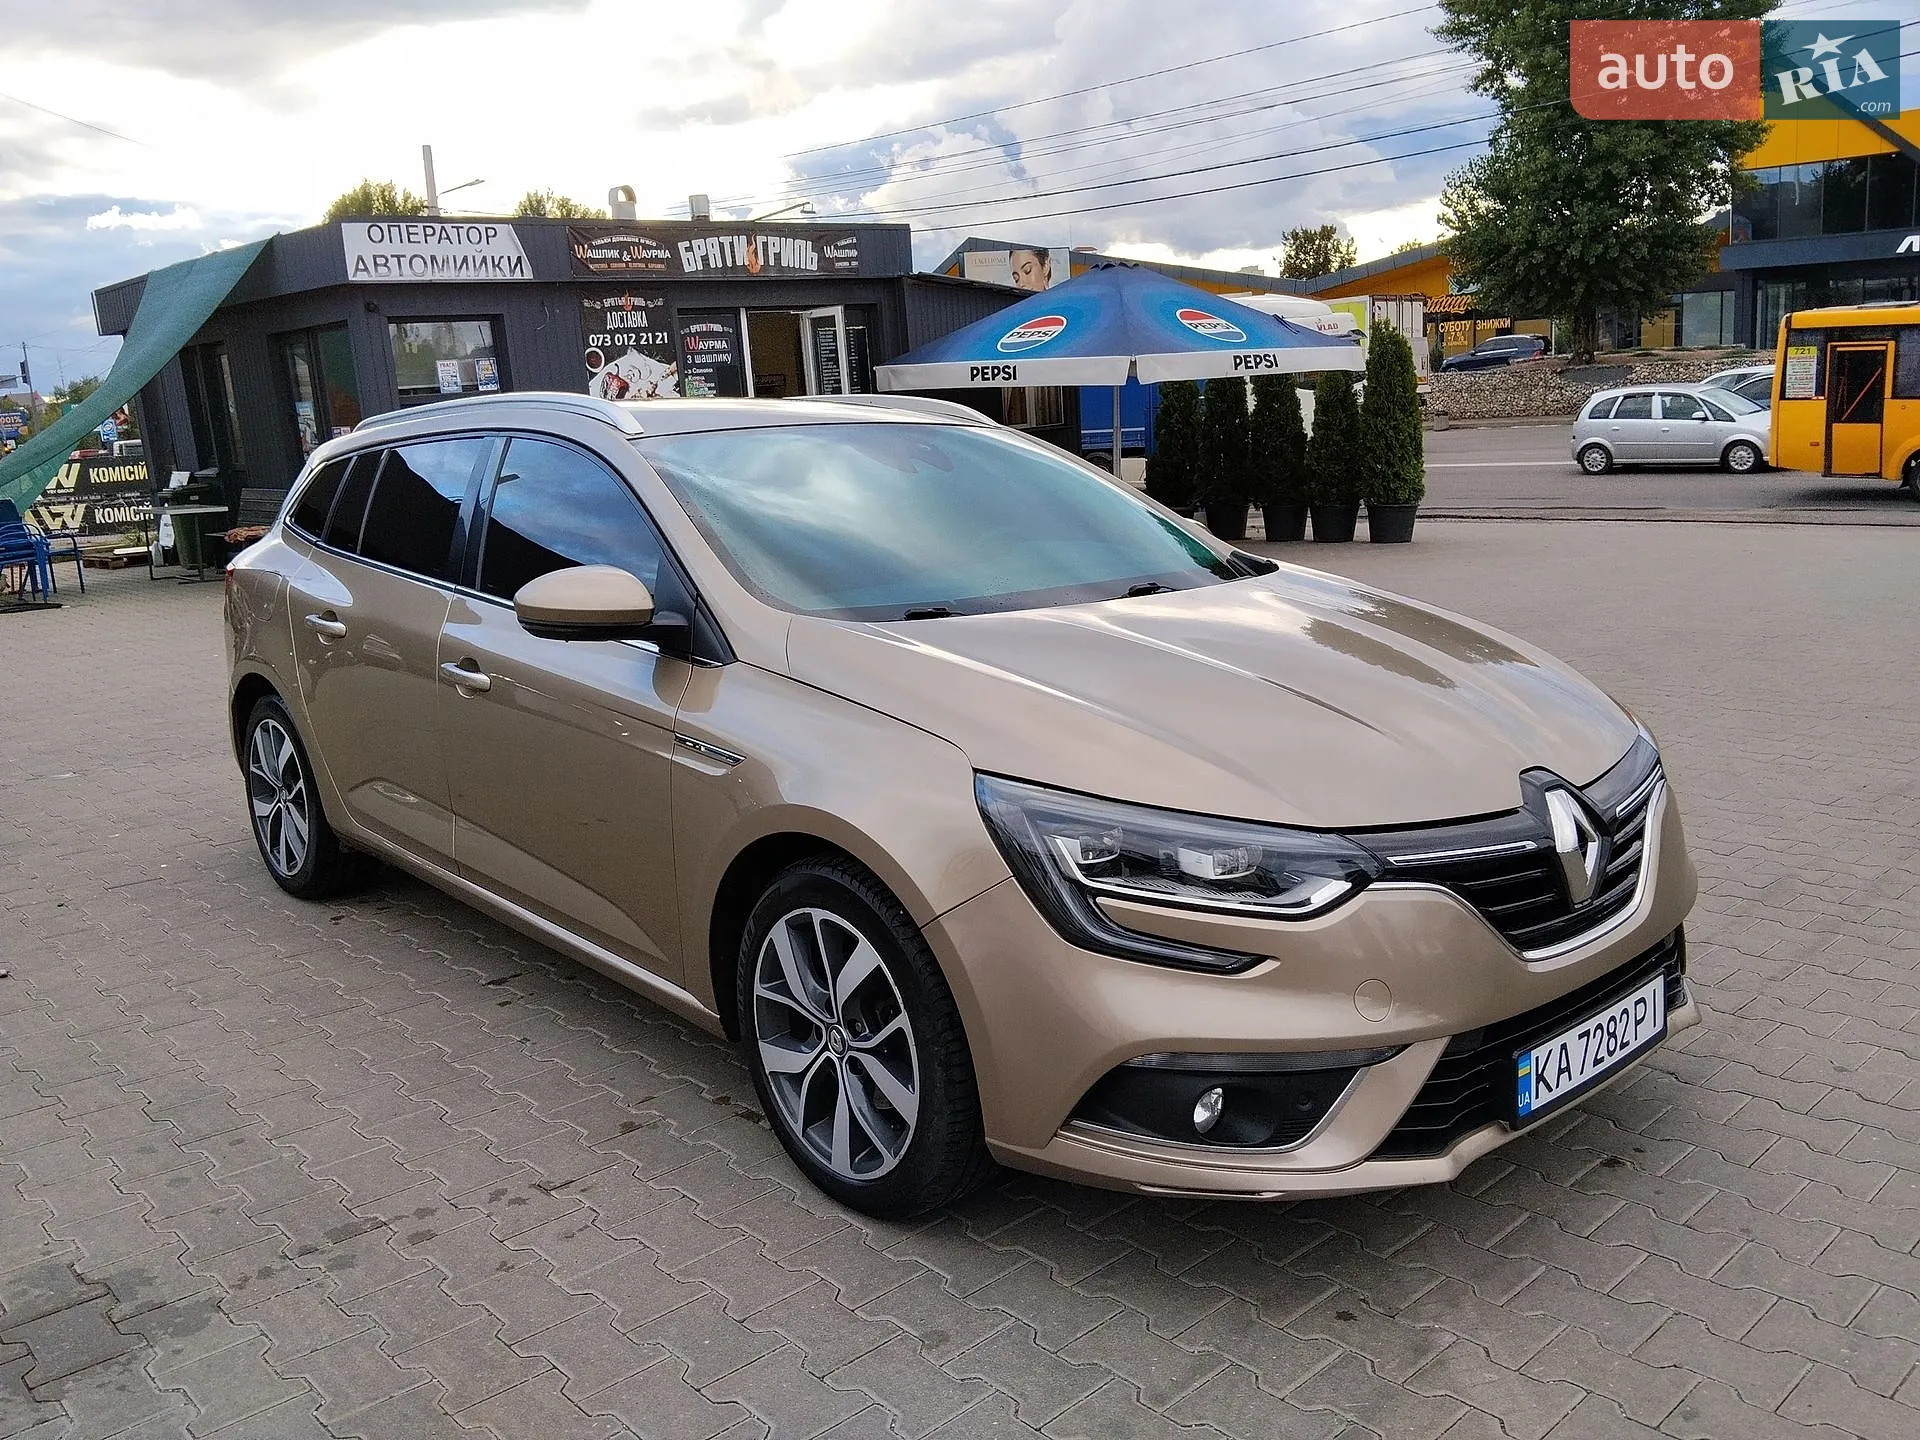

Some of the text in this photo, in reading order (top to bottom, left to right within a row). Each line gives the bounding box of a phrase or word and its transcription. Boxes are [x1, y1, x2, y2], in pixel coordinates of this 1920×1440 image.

[367, 223, 498, 246] ОПЕРАТОР
[756, 235, 819, 271] ГРИЛЬ
[352, 248, 526, 279] АВТОМИЙКИ
[606, 311, 649, 330] ДОСТАВКА
[1188, 320, 1233, 331] PEPSI
[1316, 322, 1339, 331] VLAD
[1439, 321, 1471, 333] СУБОТУ
[1476, 317, 1511, 330] ЗНИЖКИ
[589, 332, 668, 346] 073 012 21 21
[1007, 330, 1057, 339] PEPSI
[694, 353, 732, 364] шашлику
[1794, 347, 1811, 355] 721
[1232, 353, 1279, 371] PEPSI
[969, 364, 1018, 382] PEPSI
[89, 461, 149, 484] КОМІСІЙ
[1534, 1041, 1573, 1101] KA
[1577, 1007, 1631, 1076] 7282
[1518, 1091, 1531, 1108] UA
